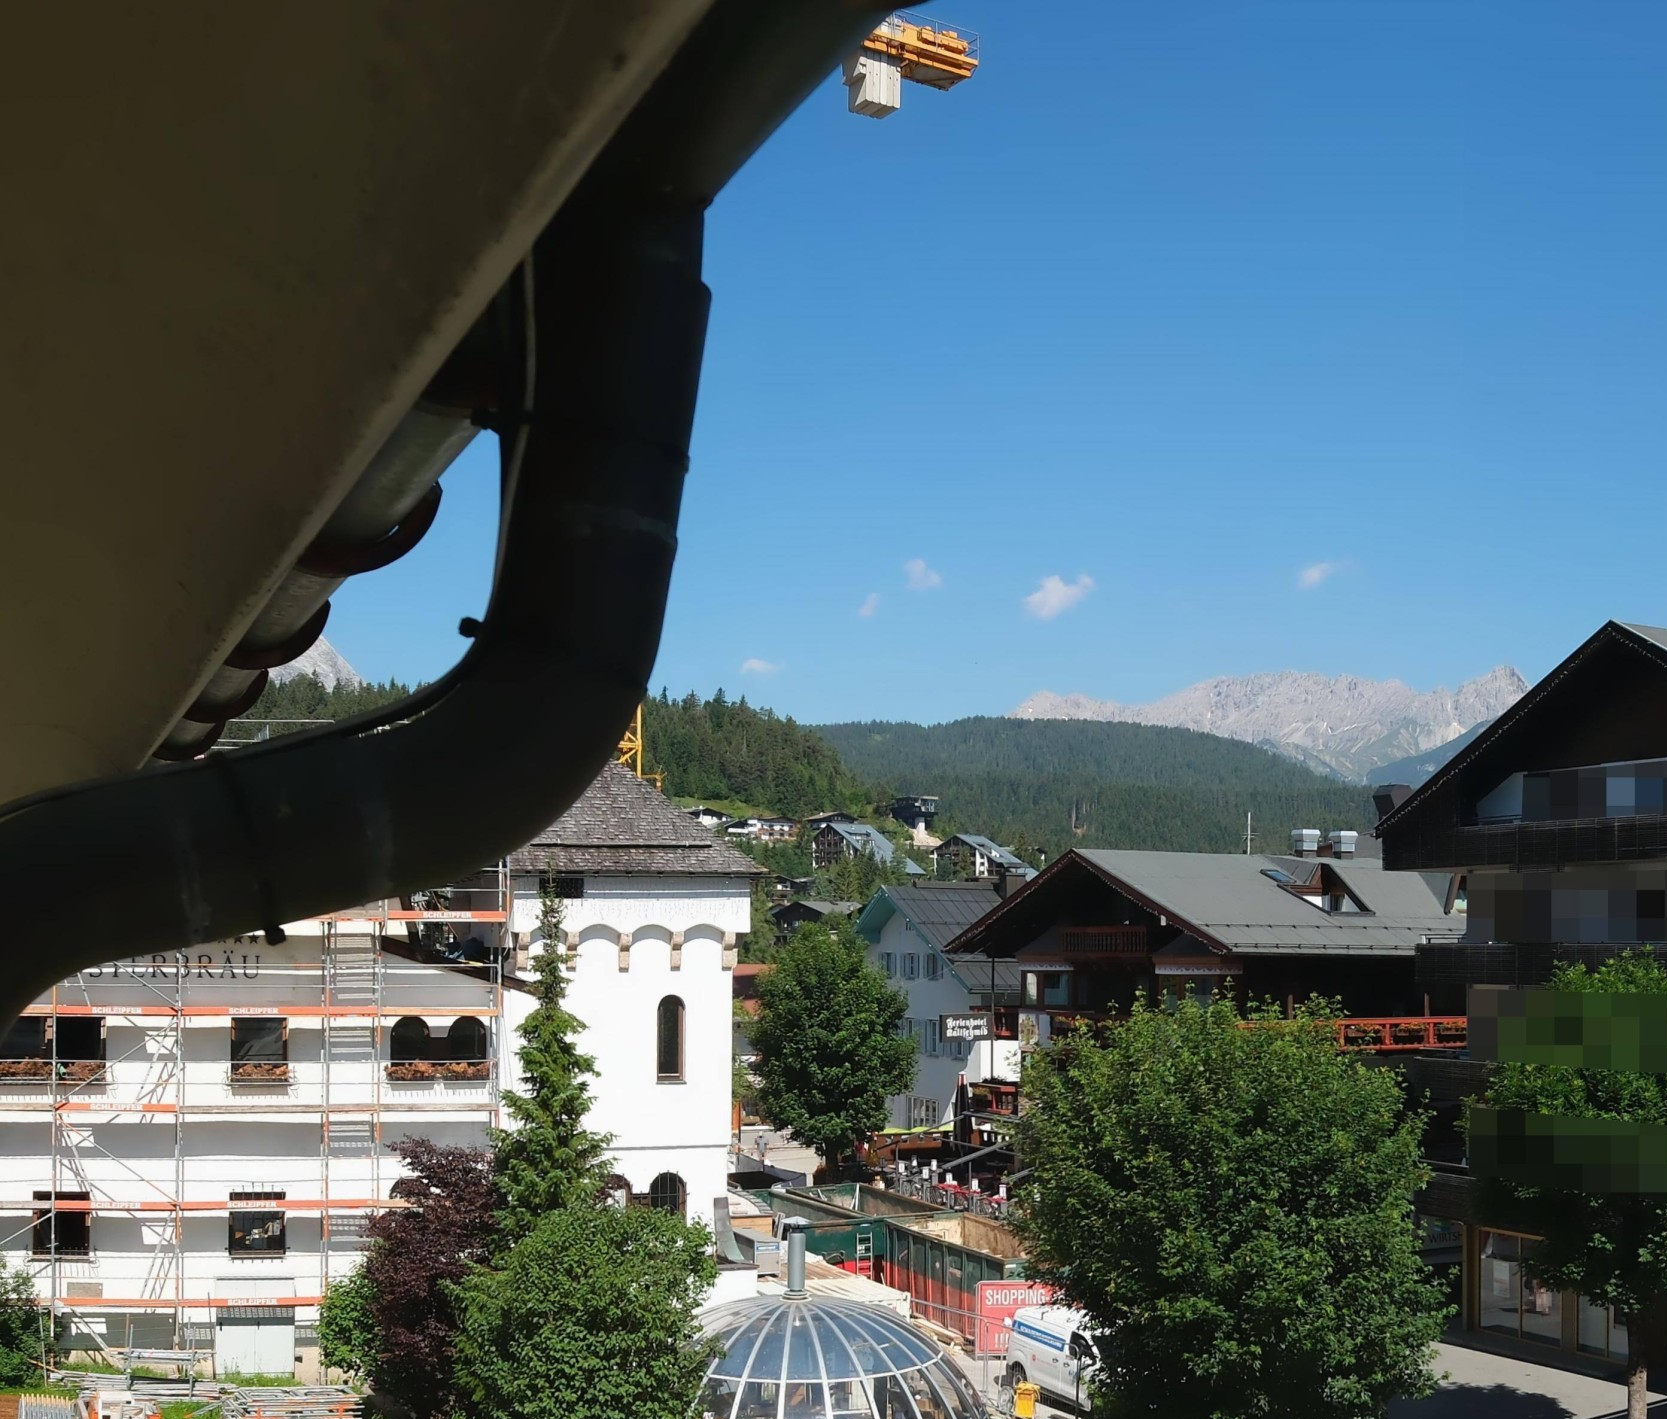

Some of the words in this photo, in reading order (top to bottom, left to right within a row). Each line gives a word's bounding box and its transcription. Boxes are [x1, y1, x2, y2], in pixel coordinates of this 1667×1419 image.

[422, 911, 472, 919] SCHLEIPFER
[90, 1103, 143, 1111] SCHLEIPFER
[91, 1201, 140, 1209] SCHLEIPFER
[227, 1200, 277, 1208] SCHLEIPFER
[228, 1298, 277, 1306] SCHLEIPFER
